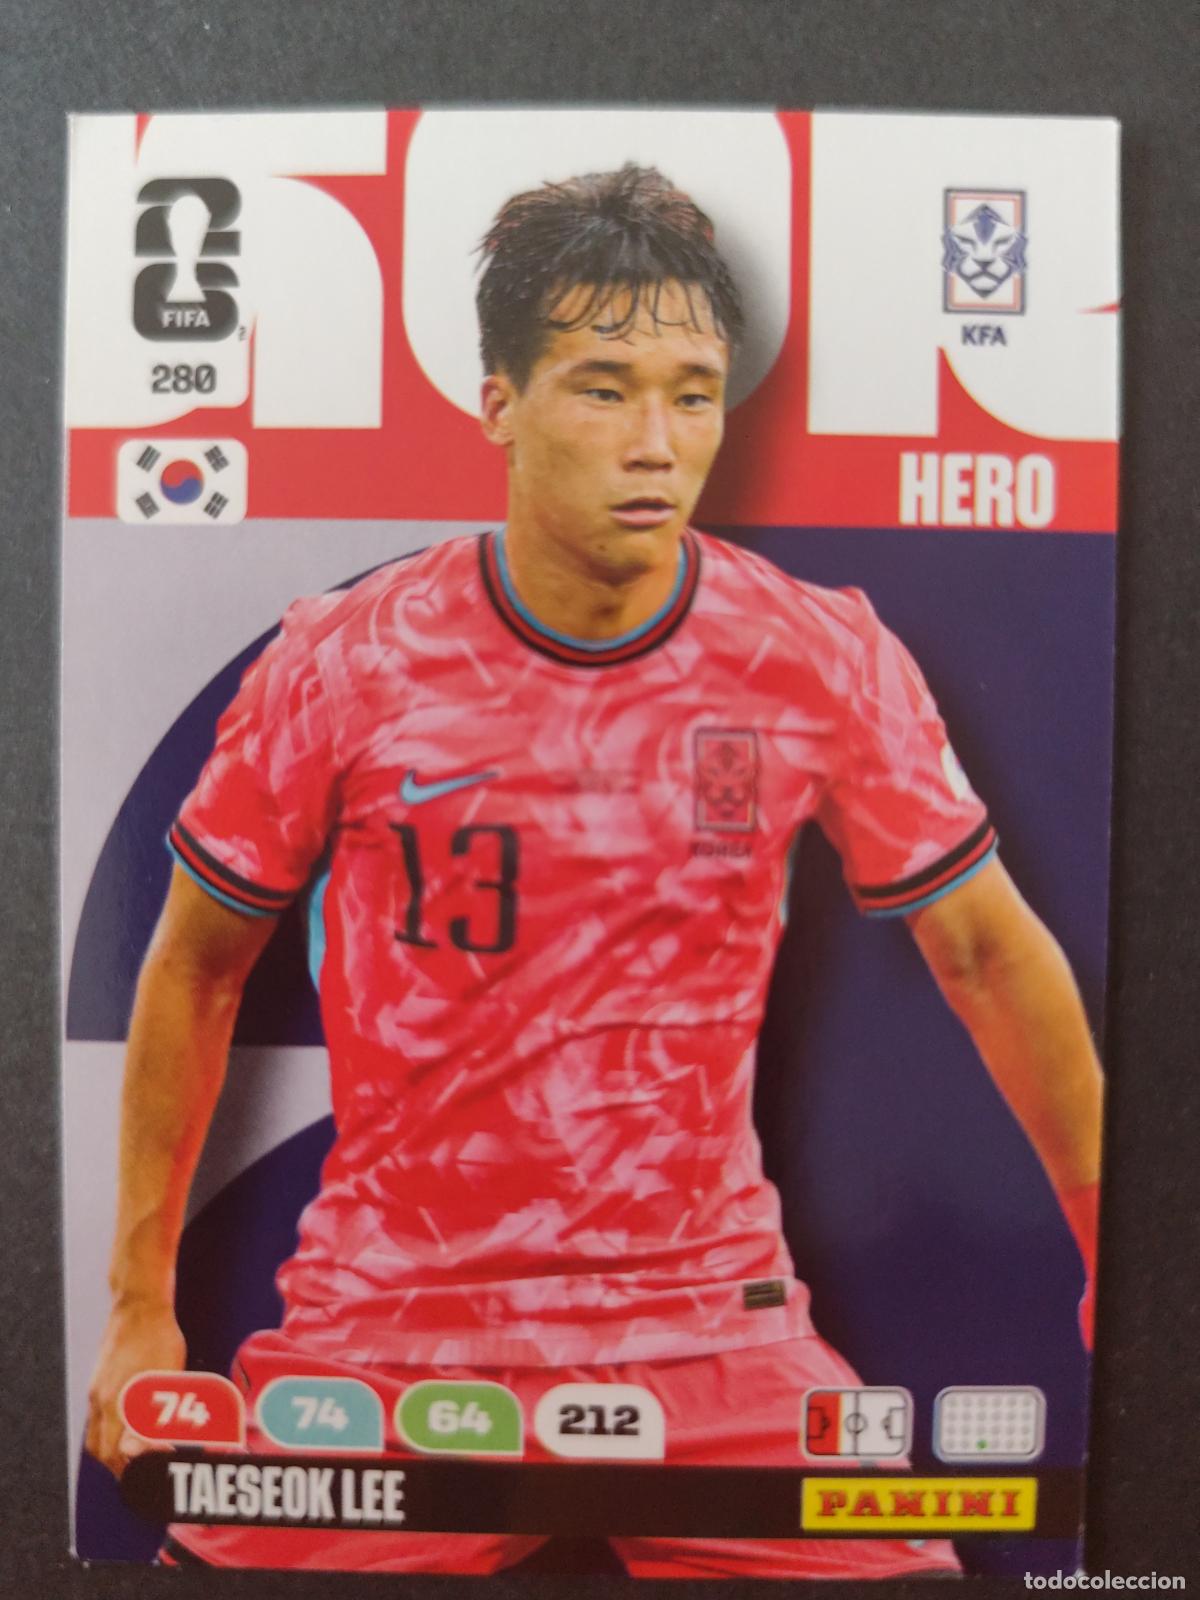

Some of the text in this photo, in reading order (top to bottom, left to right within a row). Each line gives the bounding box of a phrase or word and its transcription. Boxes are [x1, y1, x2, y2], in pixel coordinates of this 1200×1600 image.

[161, 309, 211, 329] FIFA
[961, 325, 1007, 347] KFA
[151, 364, 217, 394] 280
[899, 451, 1056, 528] HERO
[388, 821, 521, 953] 13
[151, 1391, 210, 1426] 74
[292, 1396, 350, 1431] 74
[427, 1400, 494, 1435] 64
[558, 1404, 641, 1436] 212
[169, 1462, 406, 1523] TAESEOK LEE
[817, 1489, 1022, 1518] PANINI
